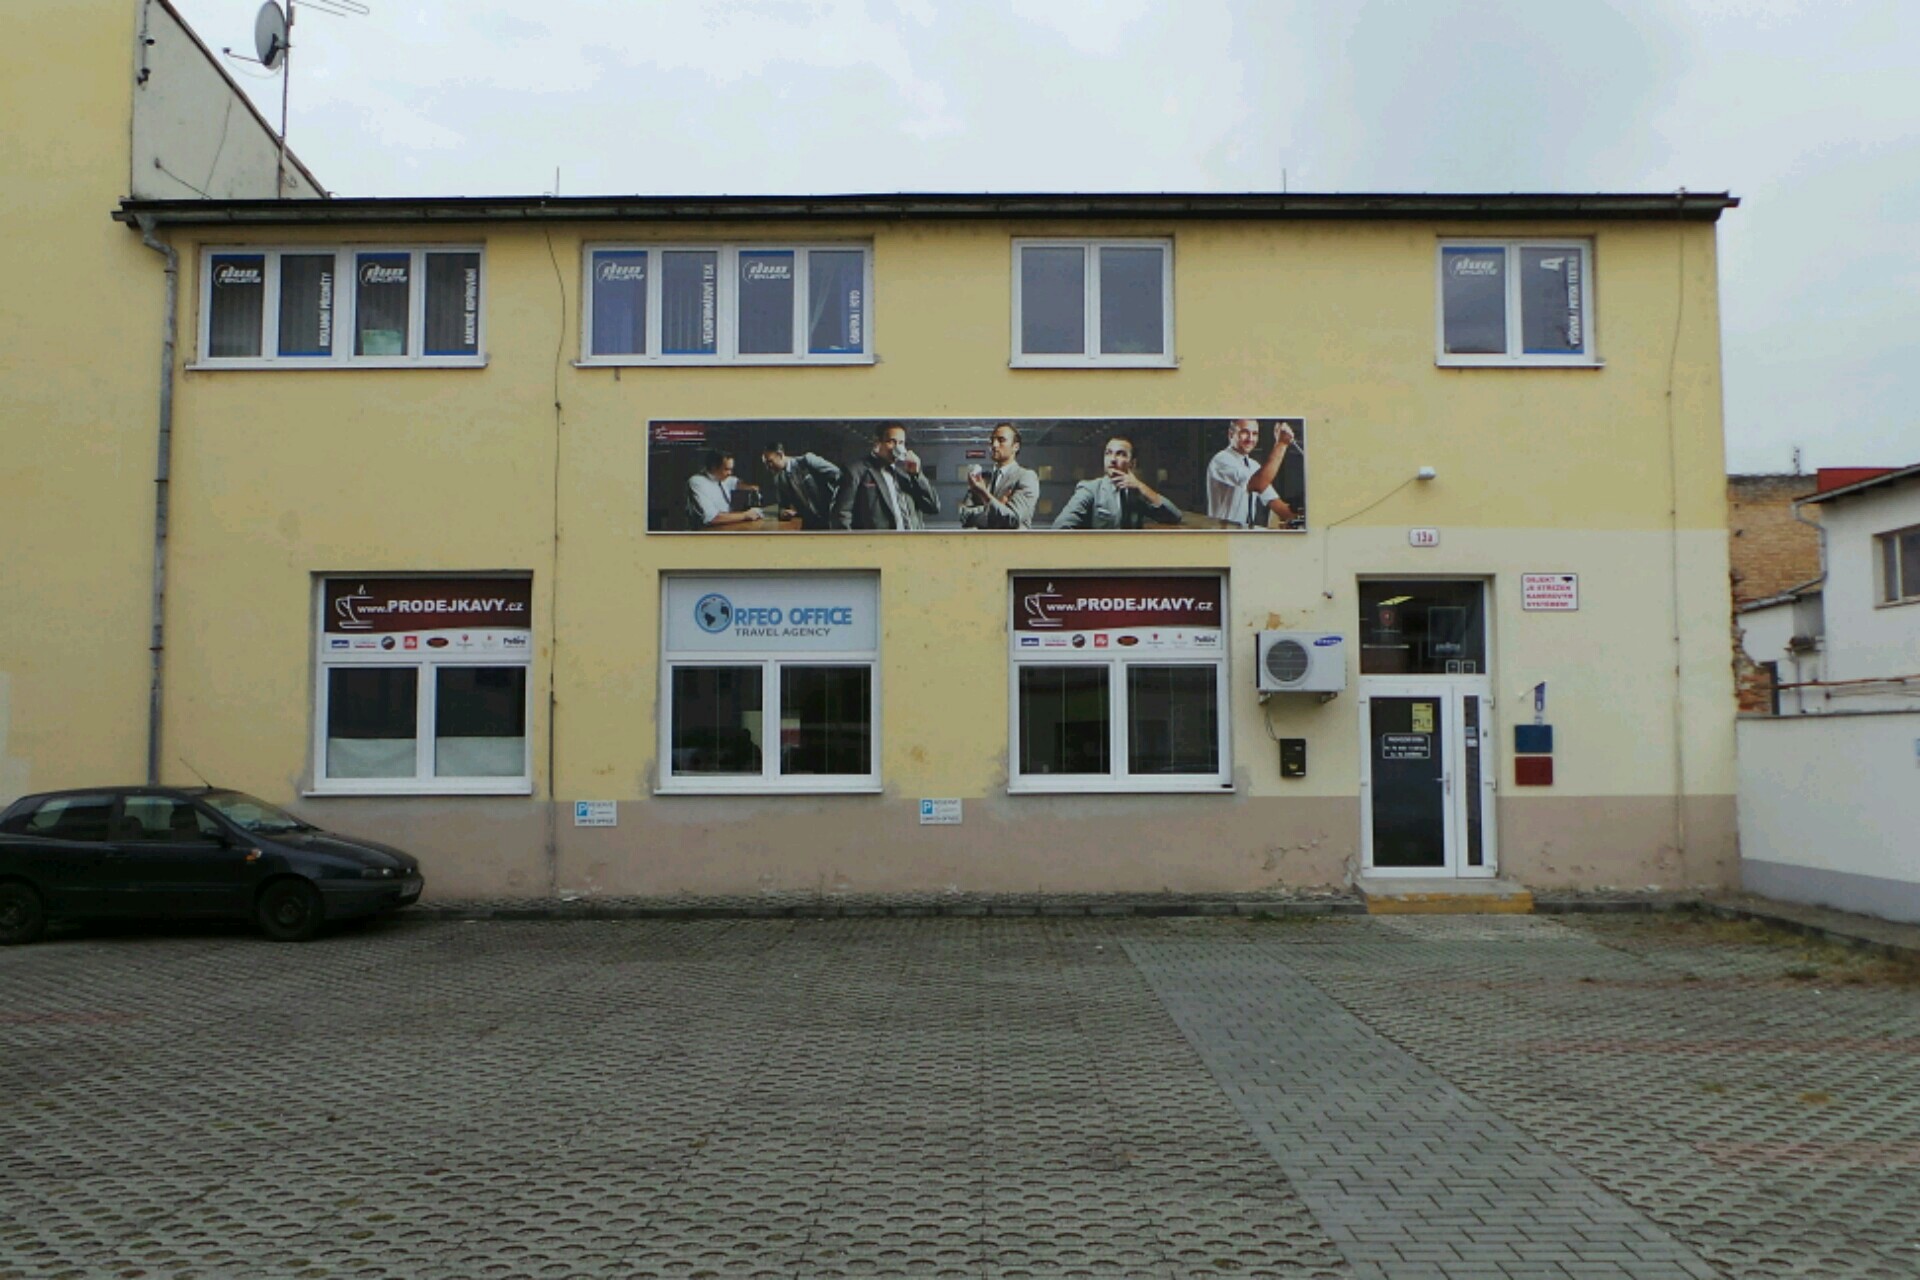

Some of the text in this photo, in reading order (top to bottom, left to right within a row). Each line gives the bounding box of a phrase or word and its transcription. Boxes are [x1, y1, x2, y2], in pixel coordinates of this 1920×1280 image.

[788, 607, 853, 625] OFFICE
[735, 627, 831, 637] TRAVEL AGENCY
